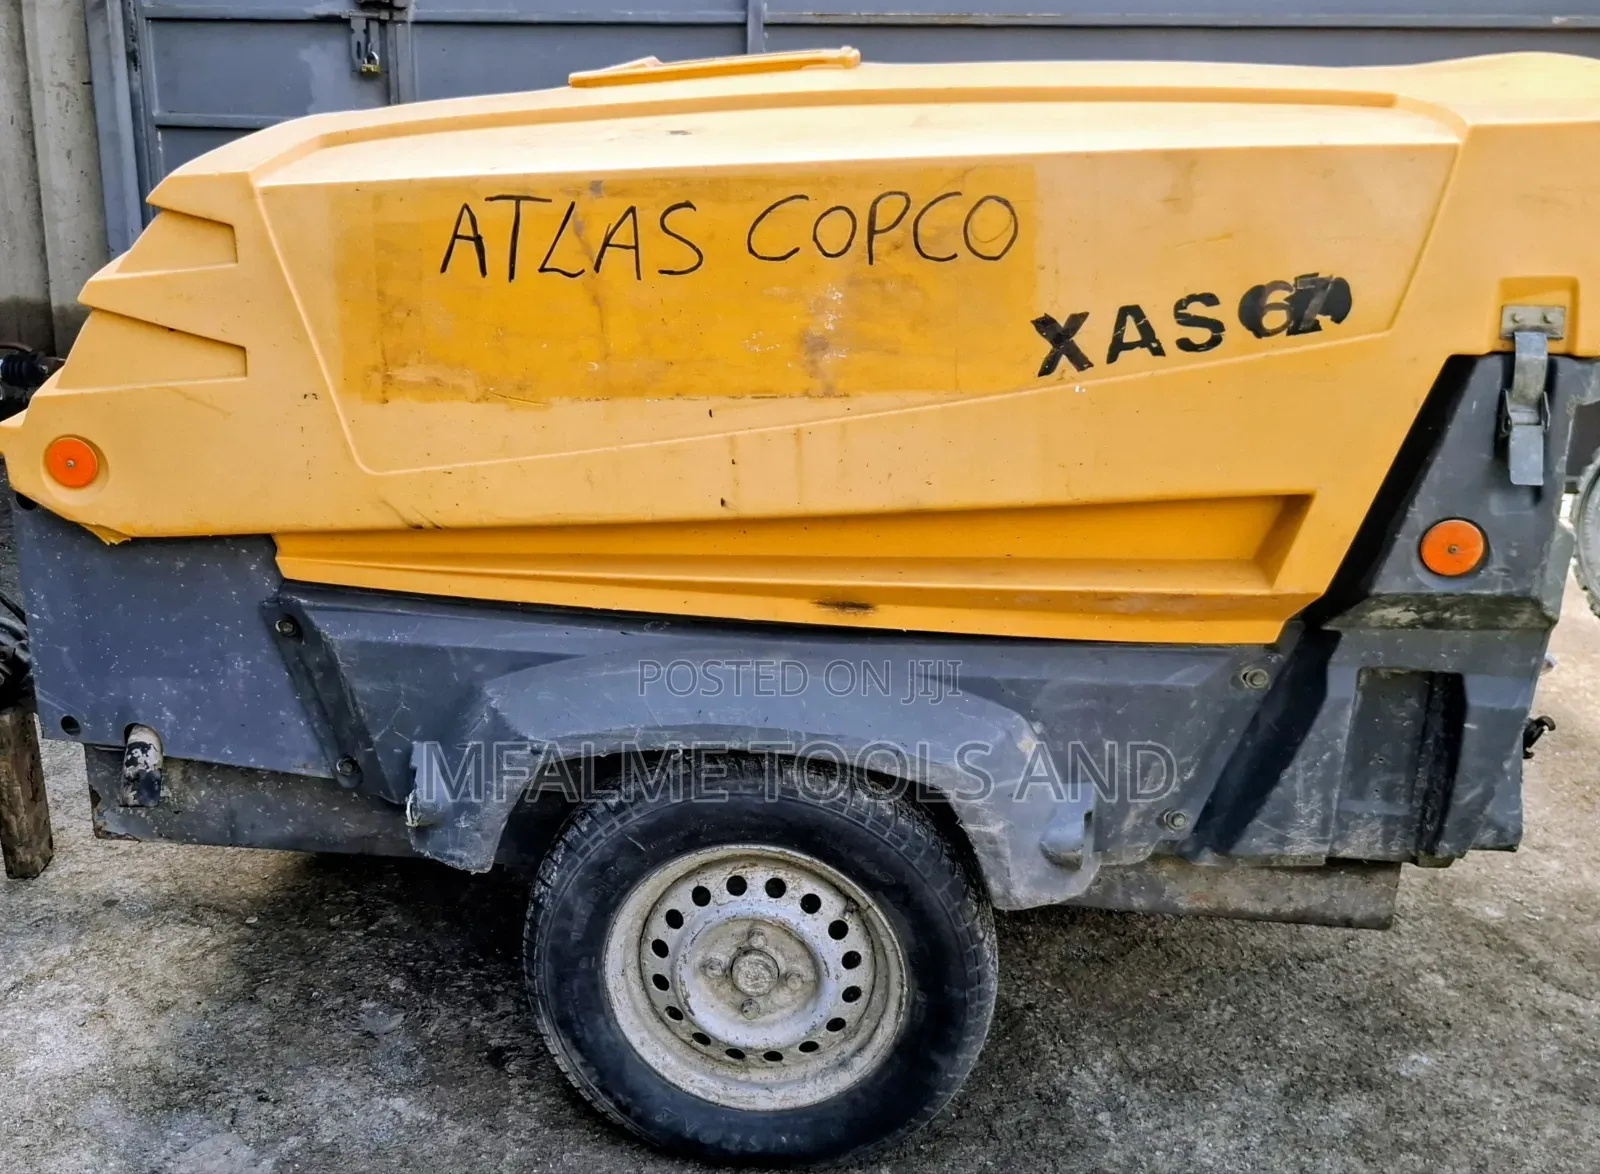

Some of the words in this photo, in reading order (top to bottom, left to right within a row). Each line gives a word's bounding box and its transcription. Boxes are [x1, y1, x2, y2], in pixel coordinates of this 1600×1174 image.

[440, 194, 703, 282] ATLAS
[747, 191, 1019, 265] COPCO
[1030, 292, 1226, 377] XAS
